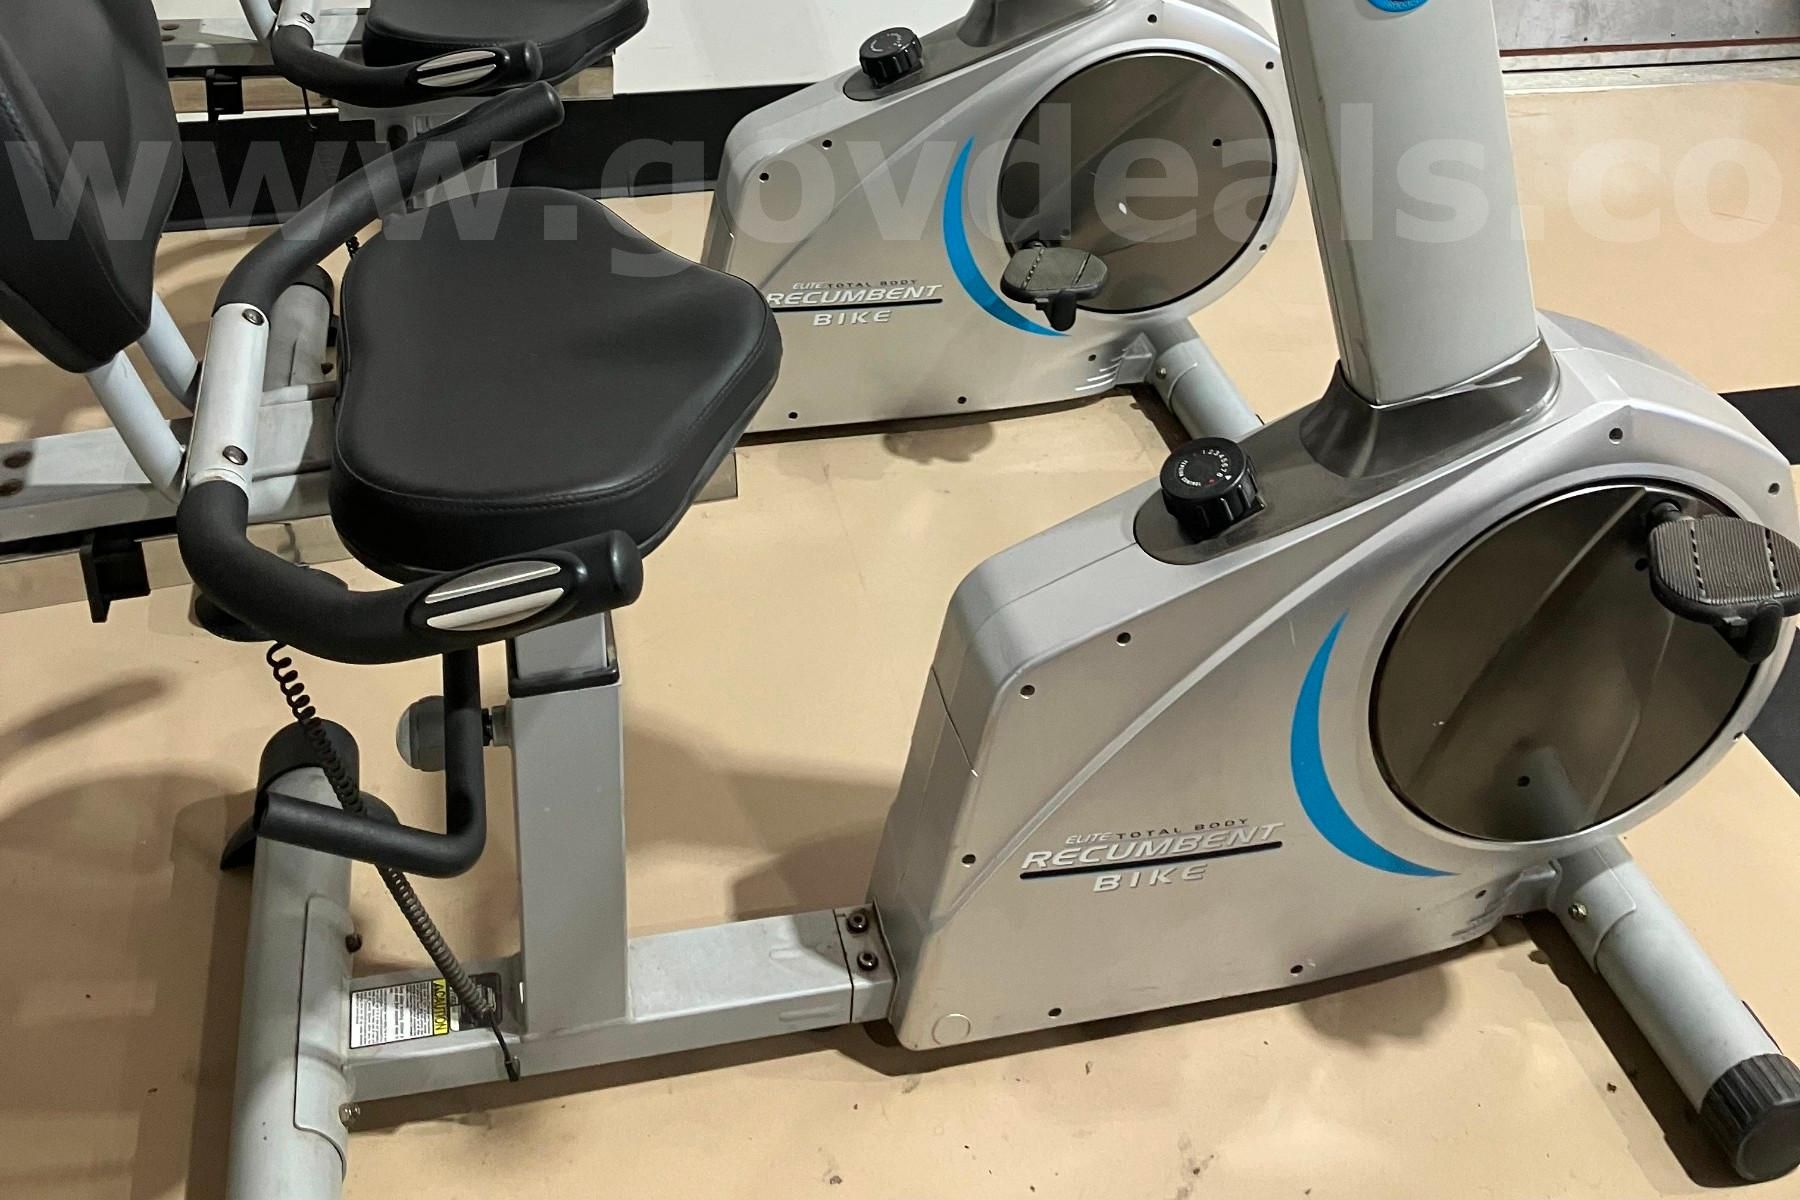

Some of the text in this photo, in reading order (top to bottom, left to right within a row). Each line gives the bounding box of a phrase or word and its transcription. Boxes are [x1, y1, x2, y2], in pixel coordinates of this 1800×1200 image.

[767, 284, 944, 305] RECUMBENT
[792, 281, 825, 289] ELITE
[813, 310, 891, 326] BIKE
[1065, 818, 1248, 845] ELITE TOTAL BODY
[1021, 822, 1285, 870] RECUMBENT
[1093, 864, 1208, 893] BIKE
[435, 990, 447, 1031] CAUTION
